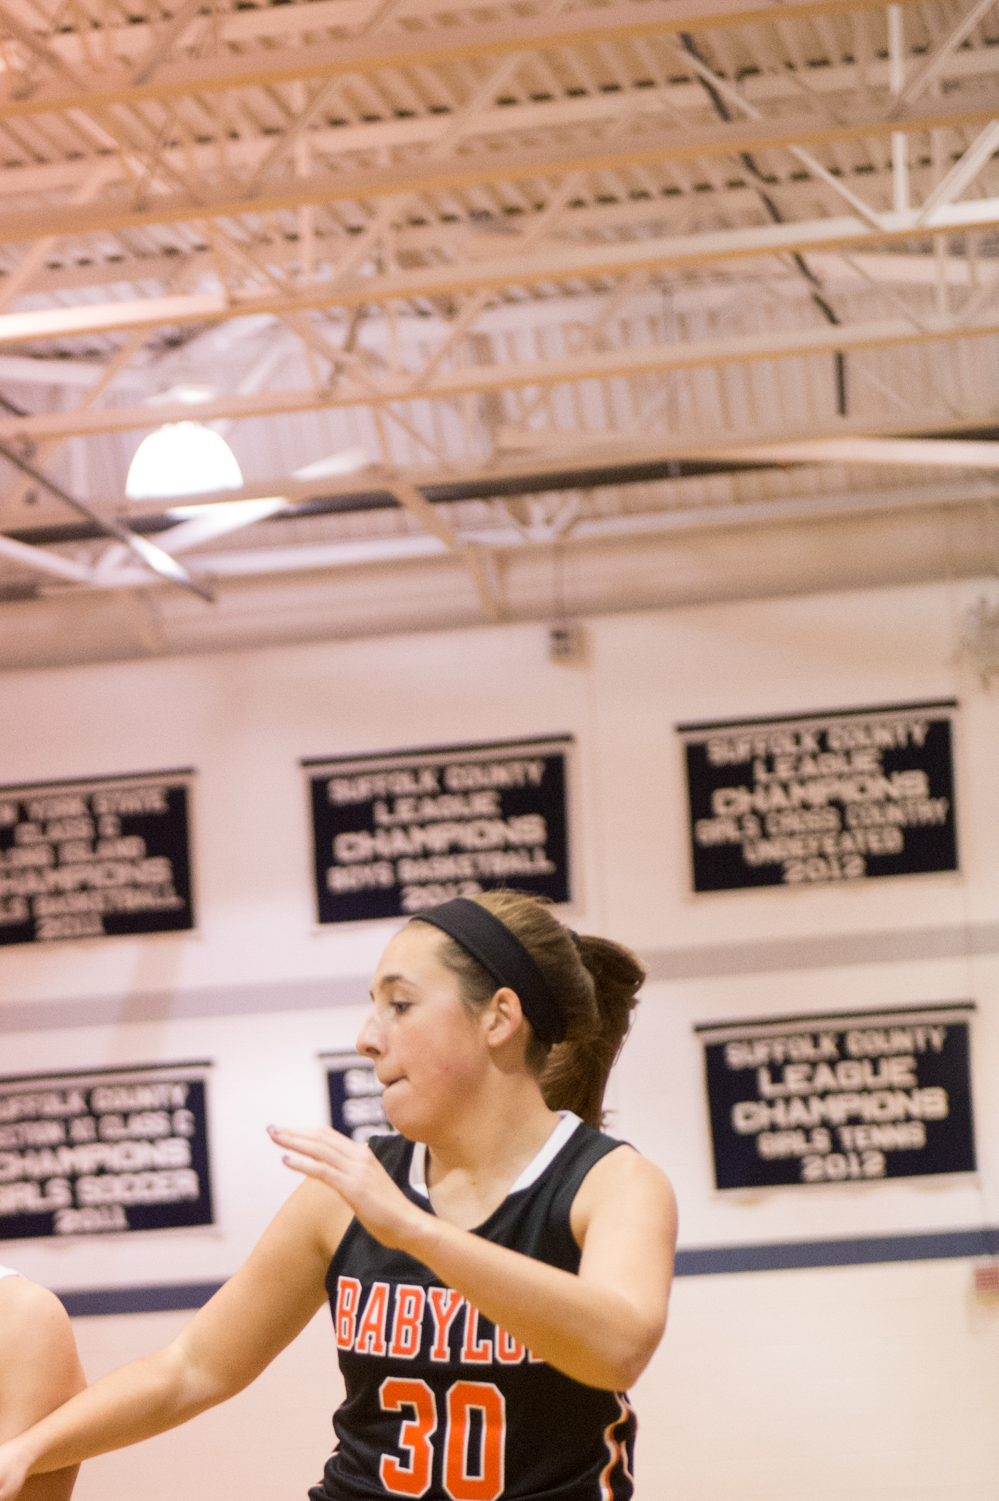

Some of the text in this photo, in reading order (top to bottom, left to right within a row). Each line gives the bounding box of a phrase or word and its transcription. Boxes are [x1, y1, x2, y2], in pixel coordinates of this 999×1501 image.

[826, 720, 929, 751] COUNTY
[327, 760, 546, 806] SUFFOLK COUNTY
[753, 749, 884, 783] LEAGUE
[373, 789, 500, 826] LEAGUE
[711, 769, 930, 817] CHAMPIONS
[333, 814, 548, 864] CHAMPIONS
[326, 849, 556, 894] BOYS BASKETBALL
[726, 1025, 948, 1071] SUFFOLK COUNTY
[757, 1055, 918, 1100] LEAGUE
[731, 1086, 949, 1136] CHAMPIONS
[756, 1120, 927, 1161] GIRLS TENNIS
[75, 1168, 200, 1207] SOCCER
[801, 1151, 887, 1183] 2012
